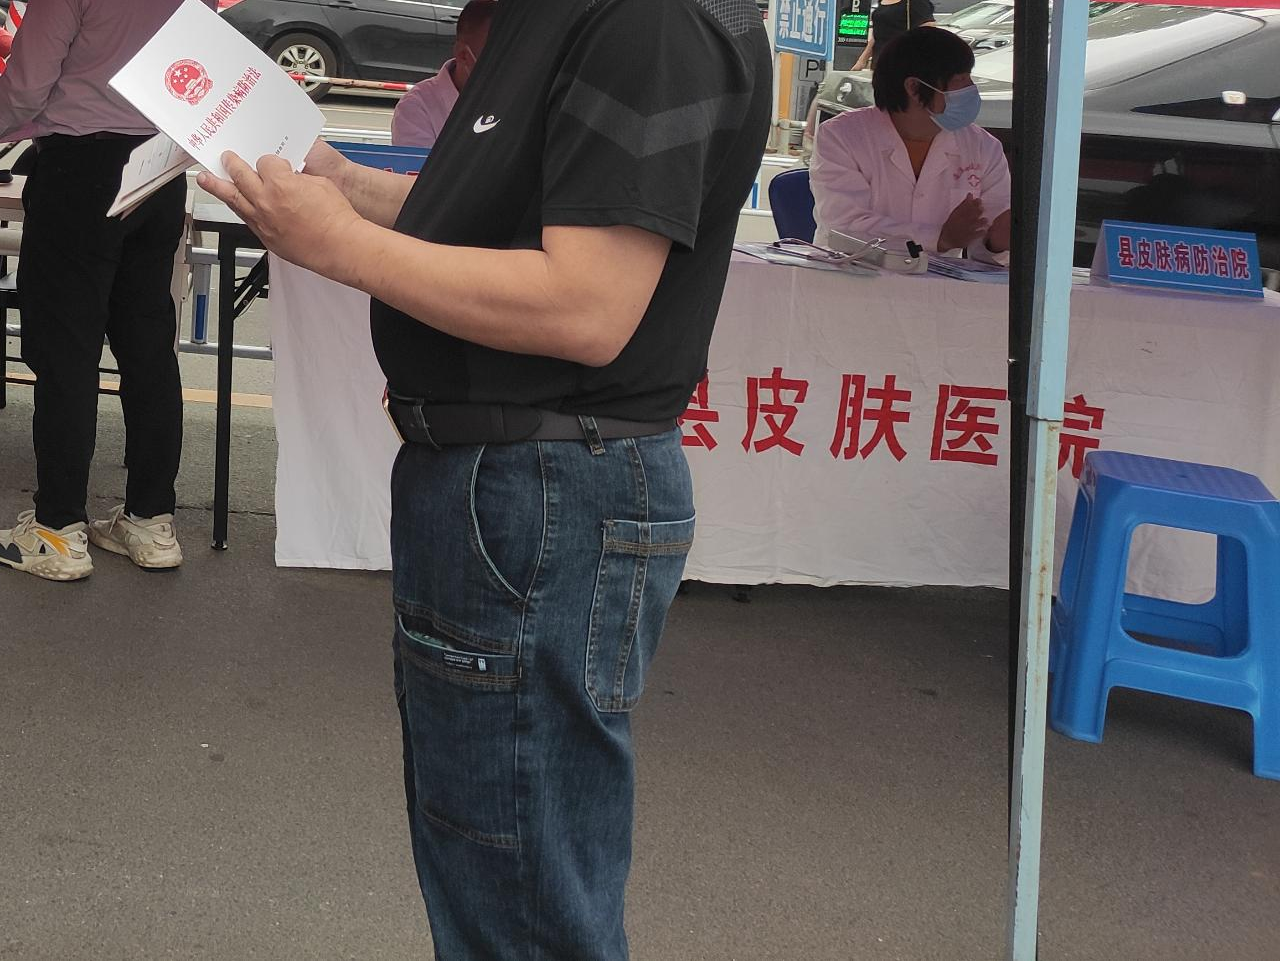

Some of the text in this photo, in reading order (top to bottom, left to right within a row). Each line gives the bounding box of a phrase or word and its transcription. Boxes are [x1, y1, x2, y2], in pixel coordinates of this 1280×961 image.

[187, 66, 262, 151] 中华人民共和国传染病防治法
[1118, 235, 1252, 280] 县皮肤病防治院
